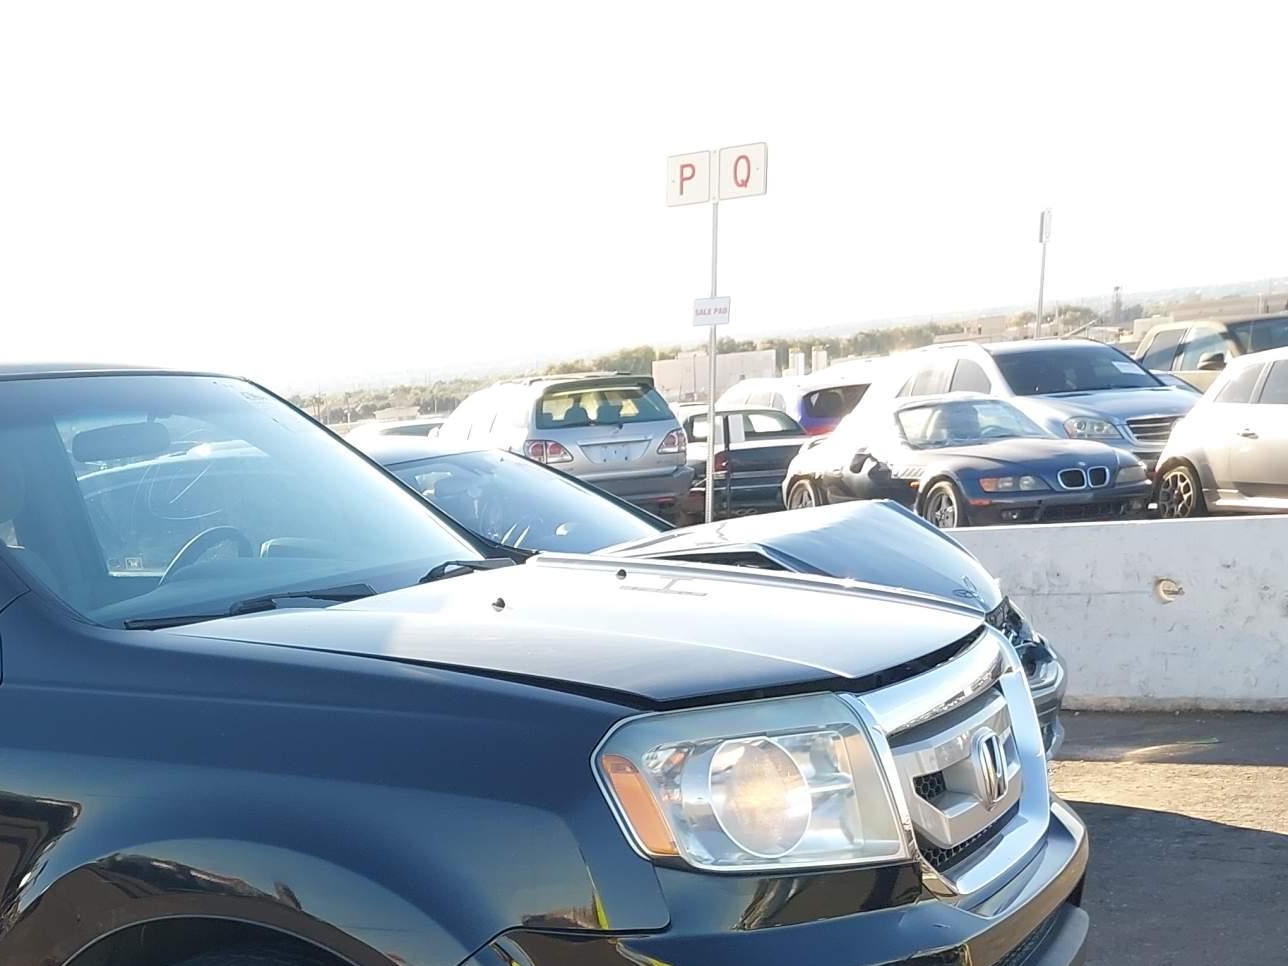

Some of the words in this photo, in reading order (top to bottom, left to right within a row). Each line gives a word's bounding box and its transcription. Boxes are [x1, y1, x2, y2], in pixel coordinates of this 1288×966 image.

[679, 163, 696, 196] P
[733, 154, 752, 189] Q
[695, 307, 712, 316] SALE
